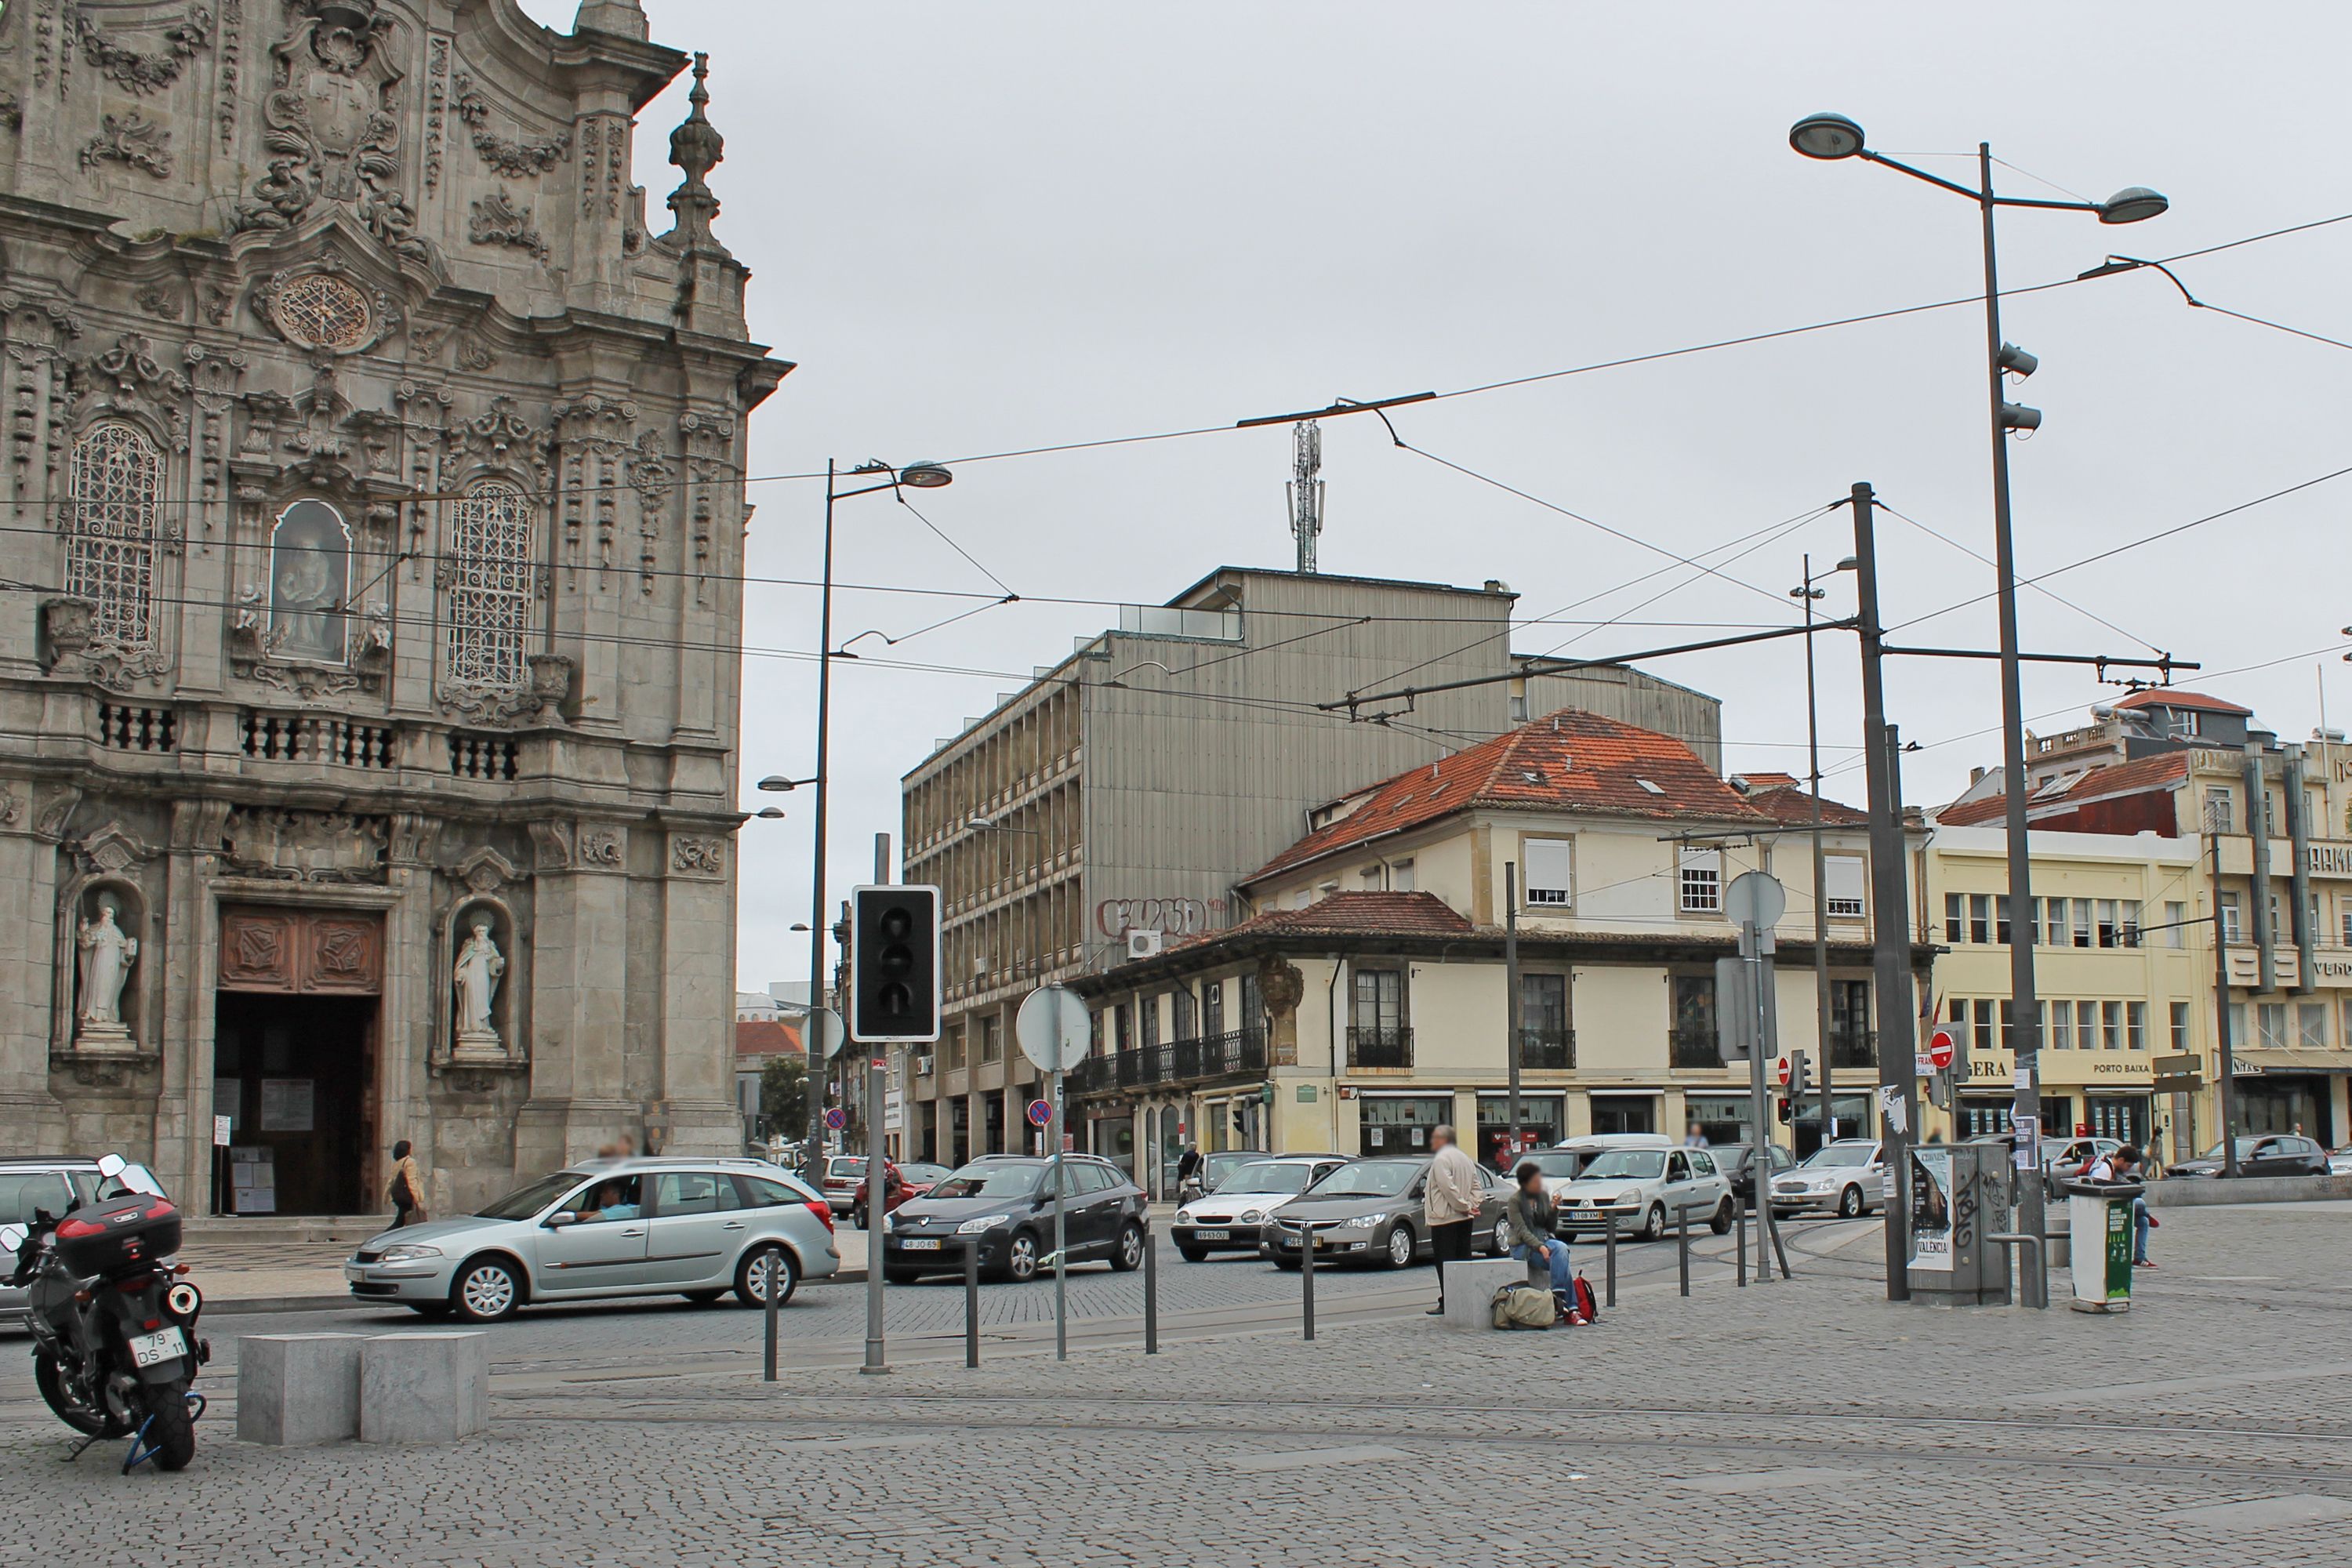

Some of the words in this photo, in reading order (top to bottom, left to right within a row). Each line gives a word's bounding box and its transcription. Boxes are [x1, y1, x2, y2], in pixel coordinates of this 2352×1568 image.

[2093, 1064, 2122, 1073] PORTO
[2125, 1065, 2150, 1073] BAIXA
[147, 1334, 165, 1348] 79
[137, 1349, 160, 1364] DS
[172, 1341, 185, 1354] 11
